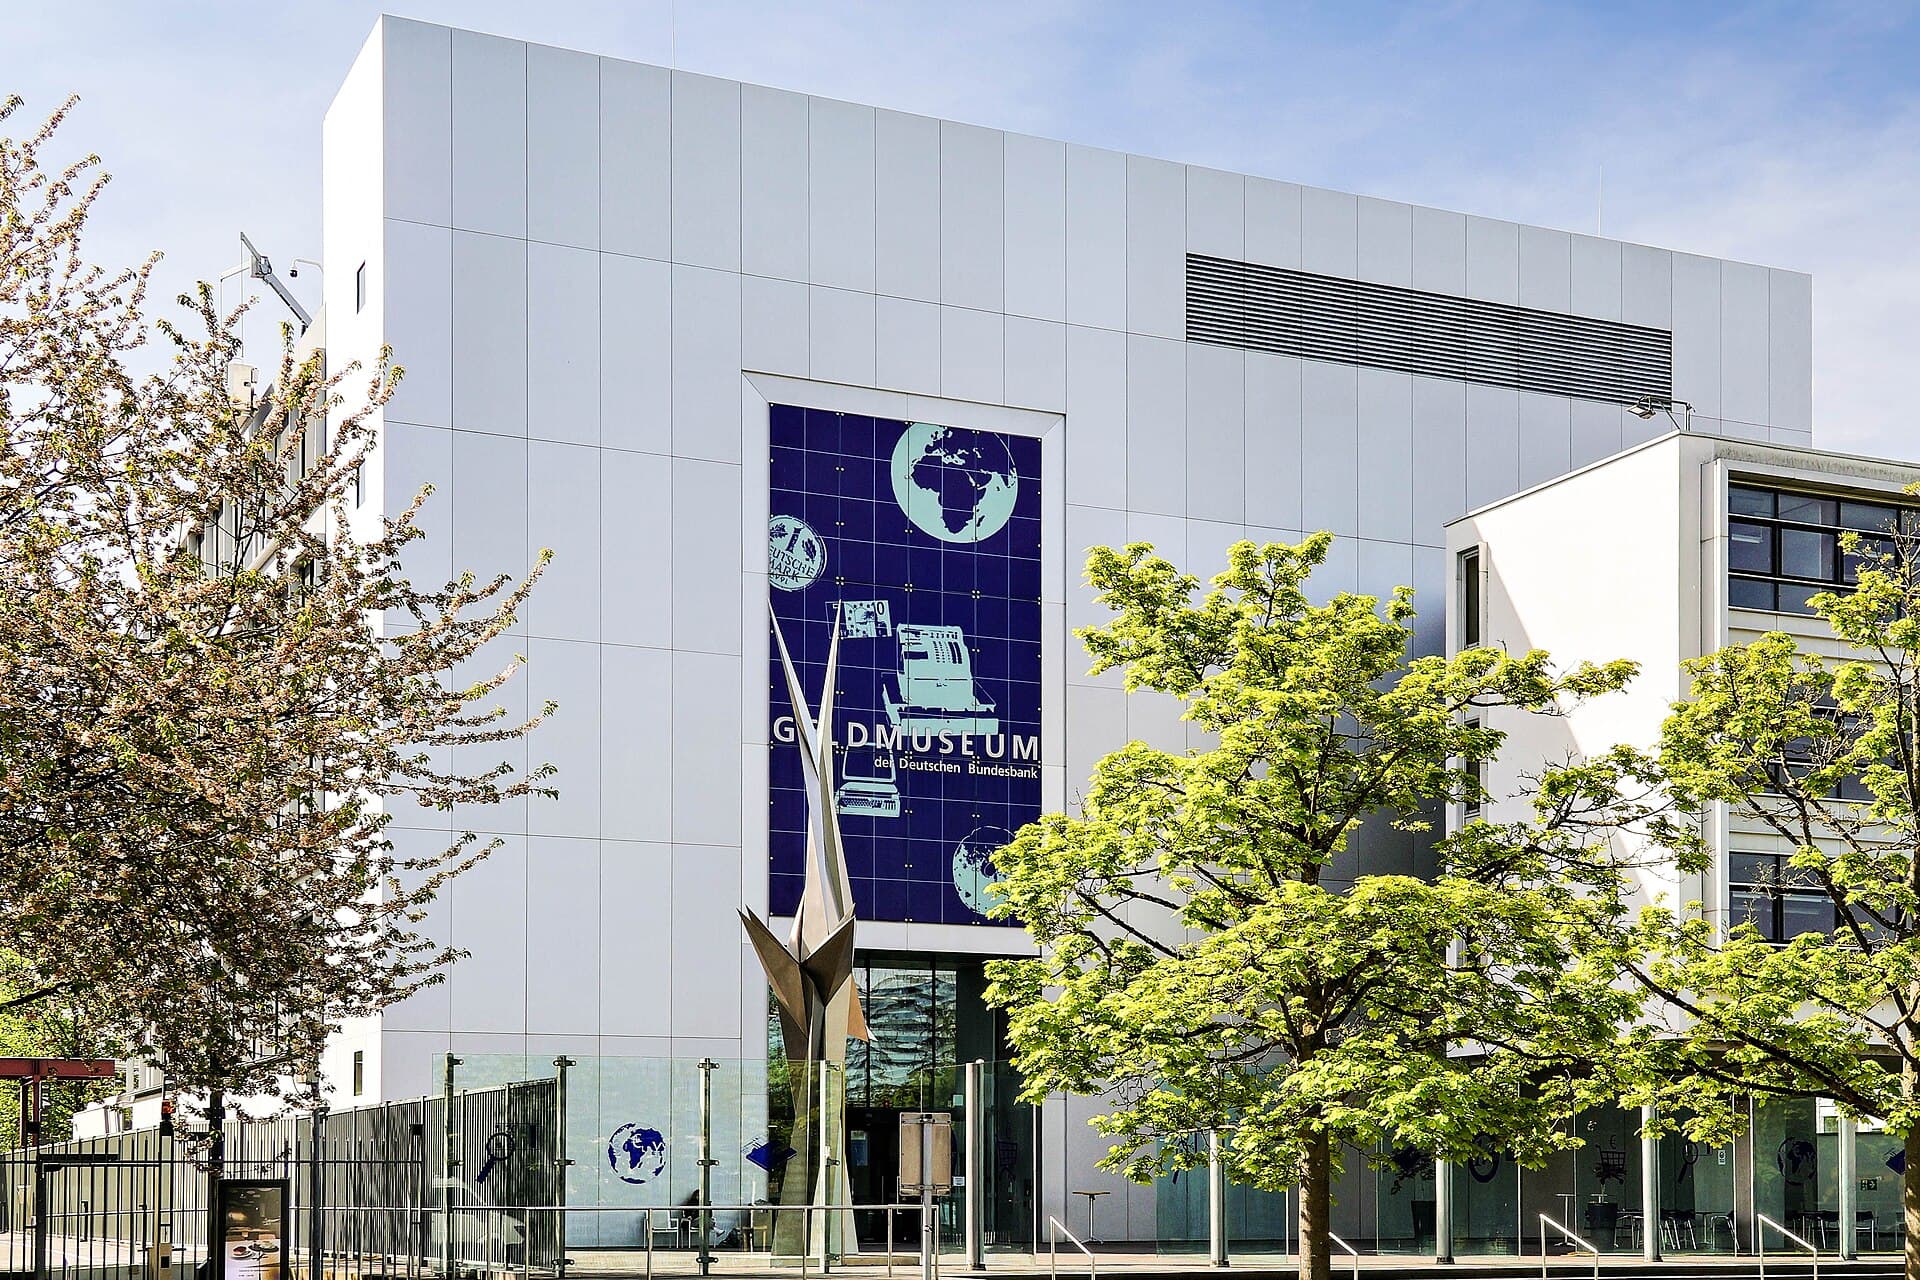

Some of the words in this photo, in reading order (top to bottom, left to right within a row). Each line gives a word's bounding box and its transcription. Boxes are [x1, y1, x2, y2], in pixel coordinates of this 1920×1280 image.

[769, 545, 815, 577] EUTSCHE
[773, 716, 1038, 761] GDMUSEUM
[874, 755, 894, 768] der
[899, 757, 961, 773] Deutschen
[968, 763, 1038, 779] Bundesbank
